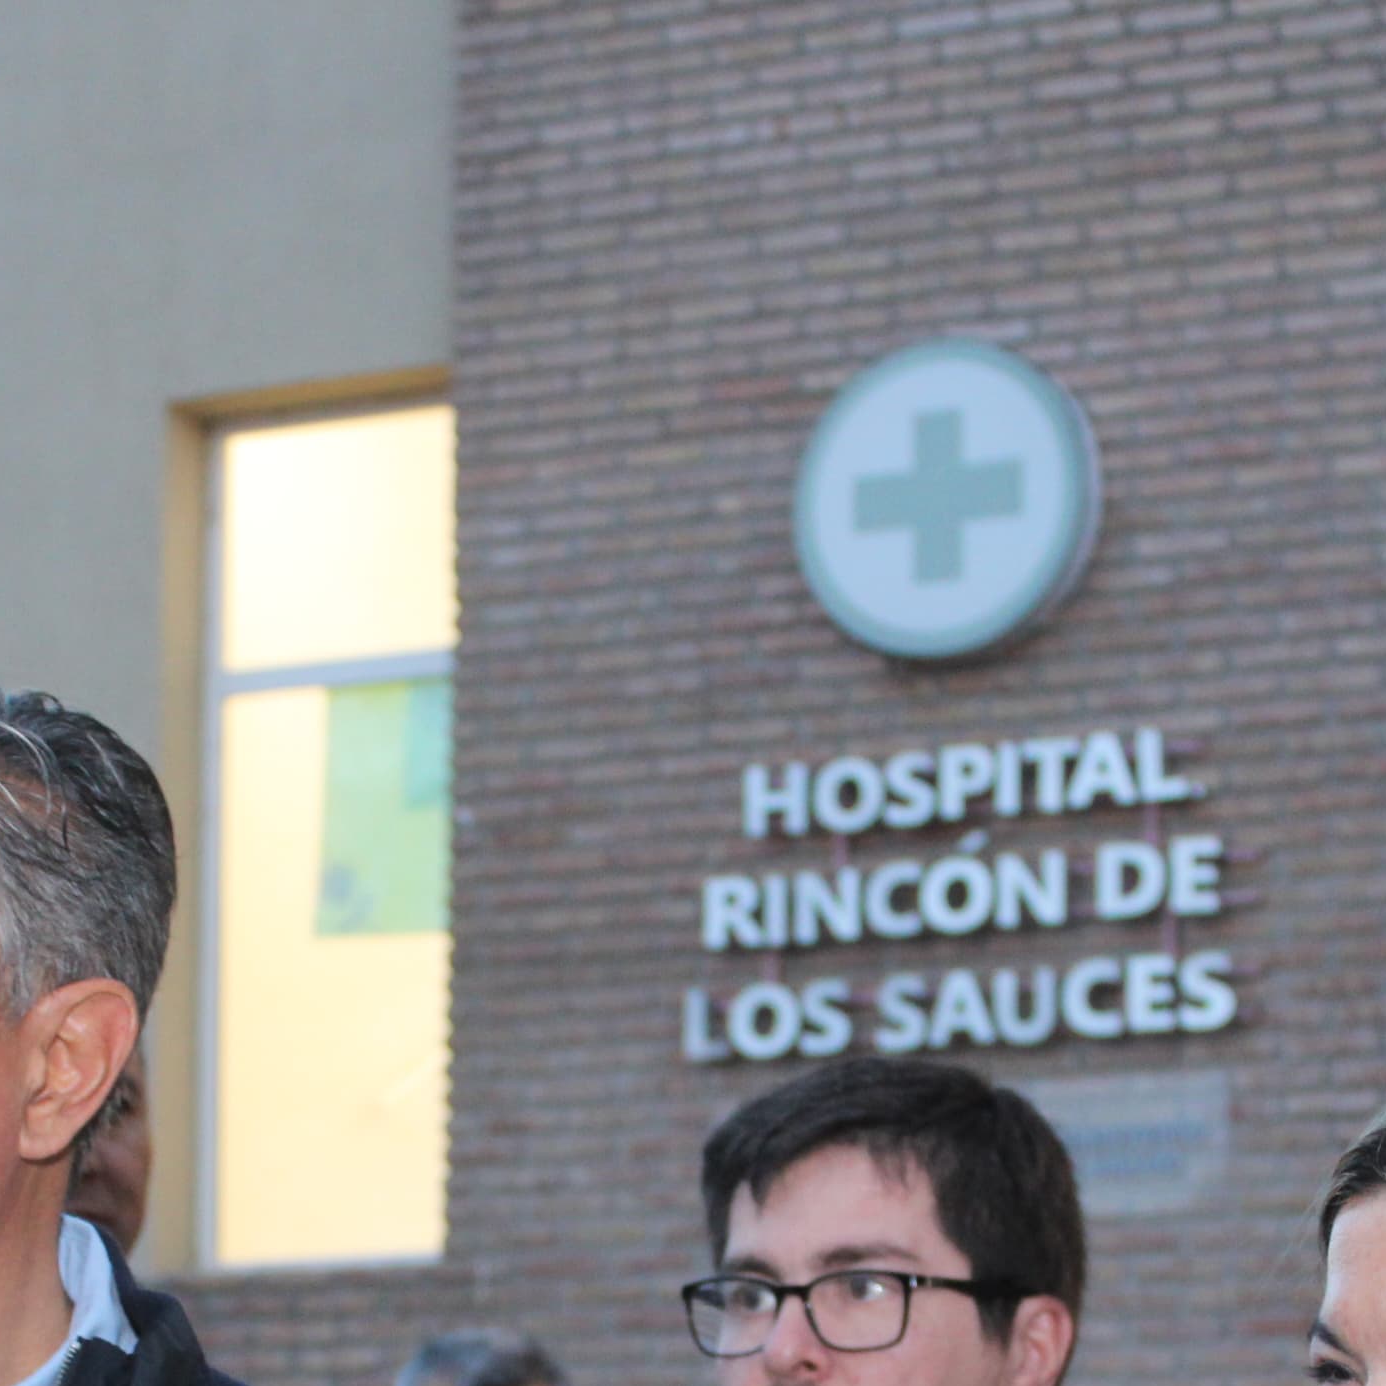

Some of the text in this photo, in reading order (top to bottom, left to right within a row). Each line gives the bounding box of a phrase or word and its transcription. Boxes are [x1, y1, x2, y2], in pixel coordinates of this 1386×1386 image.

[741, 727, 1190, 839] HOSPITAL
[702, 830, 1222, 951] RINCÓN DE
[683, 951, 1238, 1062] LOS SAUCES
